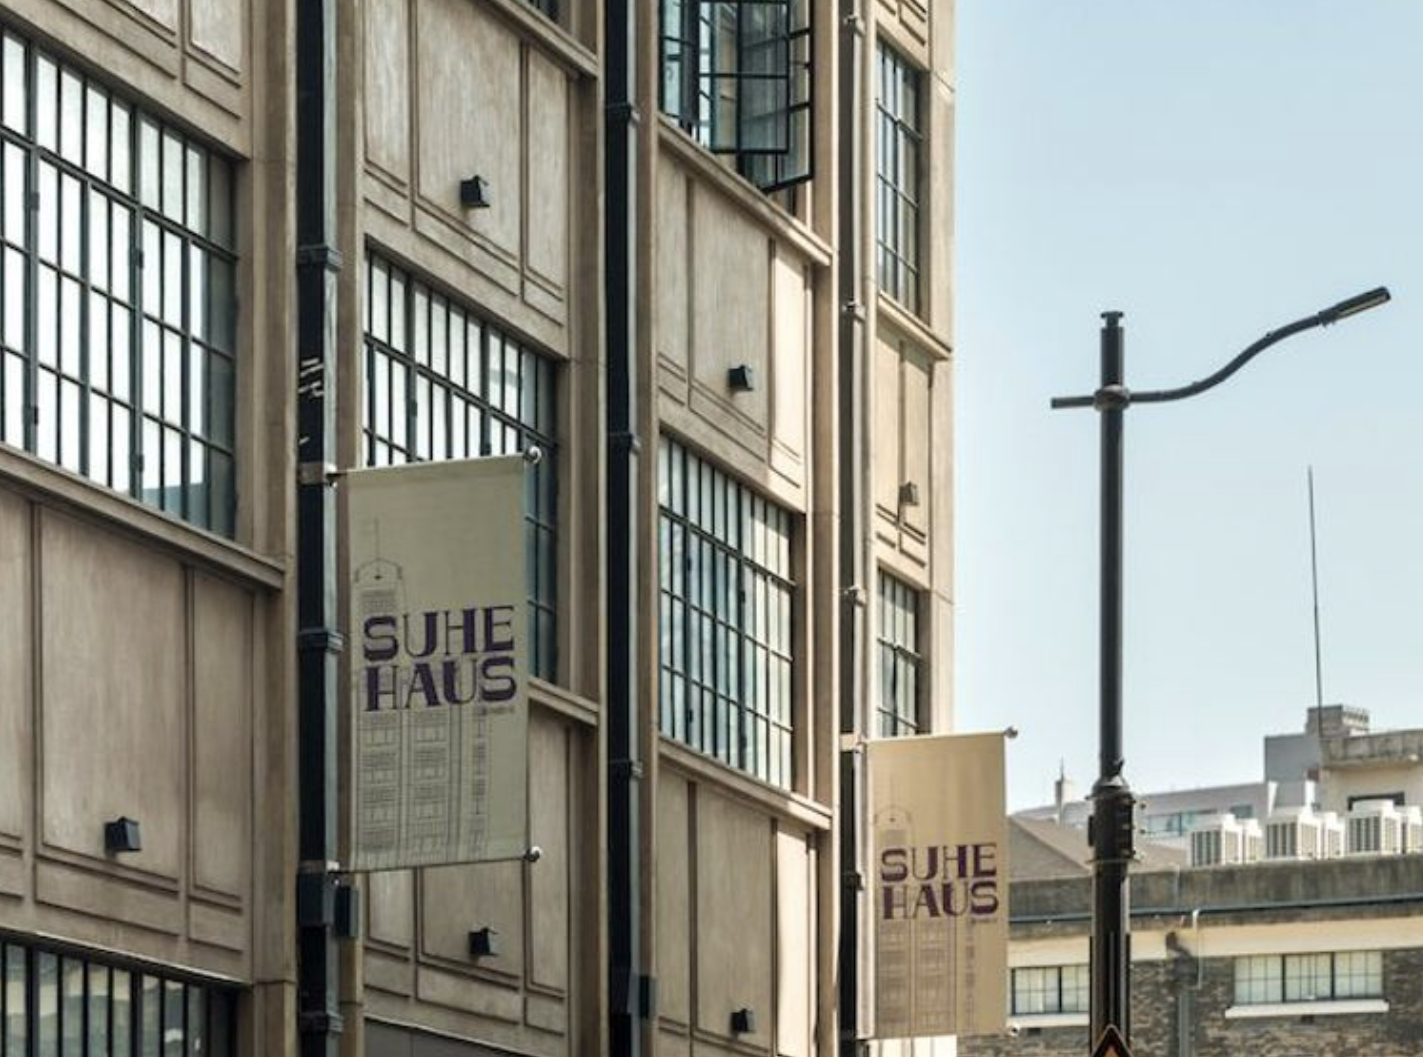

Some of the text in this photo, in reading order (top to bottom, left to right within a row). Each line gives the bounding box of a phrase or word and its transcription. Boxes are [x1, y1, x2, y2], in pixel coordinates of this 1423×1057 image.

[363, 605, 516, 662] SUHE
[363, 656, 518, 712] HAUS
[880, 843, 998, 883] SUHE
[881, 881, 1000, 920] HAUS
